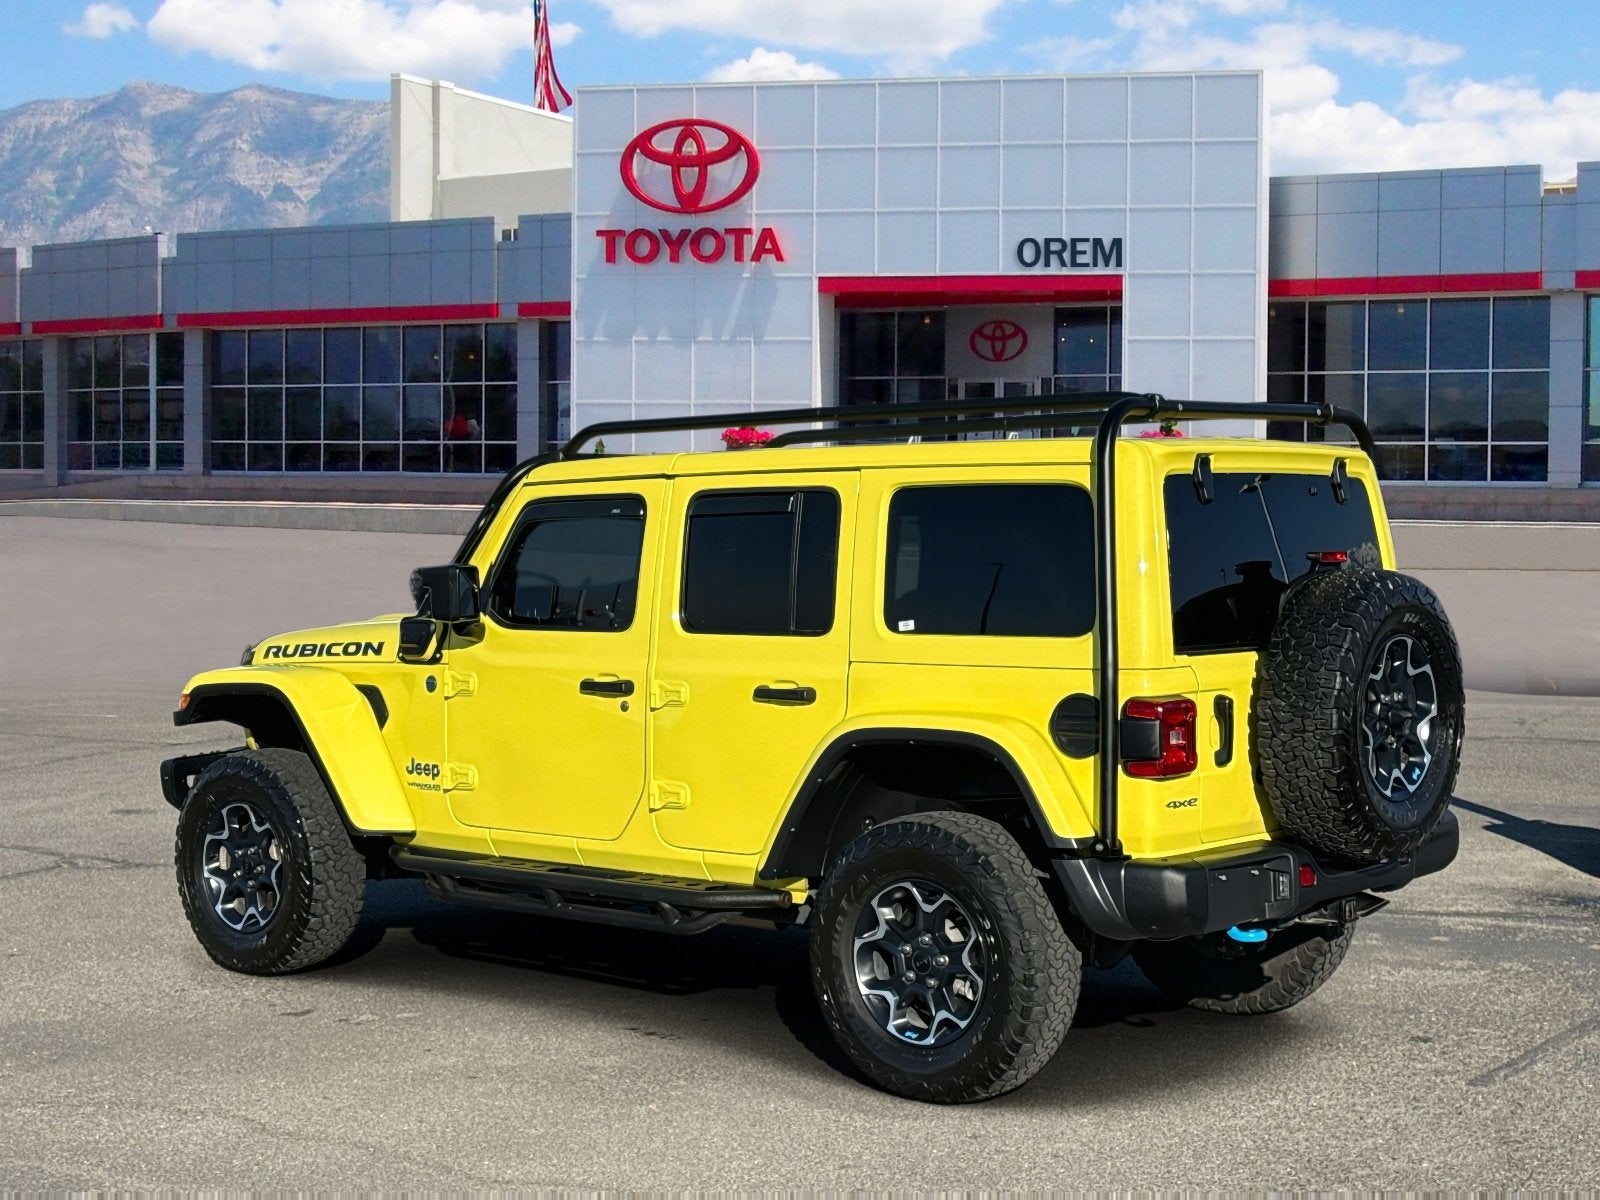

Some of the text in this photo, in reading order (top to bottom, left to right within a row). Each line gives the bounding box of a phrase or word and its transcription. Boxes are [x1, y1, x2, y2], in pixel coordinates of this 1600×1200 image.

[596, 227, 784, 264] TOYOTA
[1016, 237, 1123, 268] OREM
[263, 641, 385, 659] RUBICON
[405, 757, 441, 781] Jeep
[1165, 797, 1198, 809] 4xe
